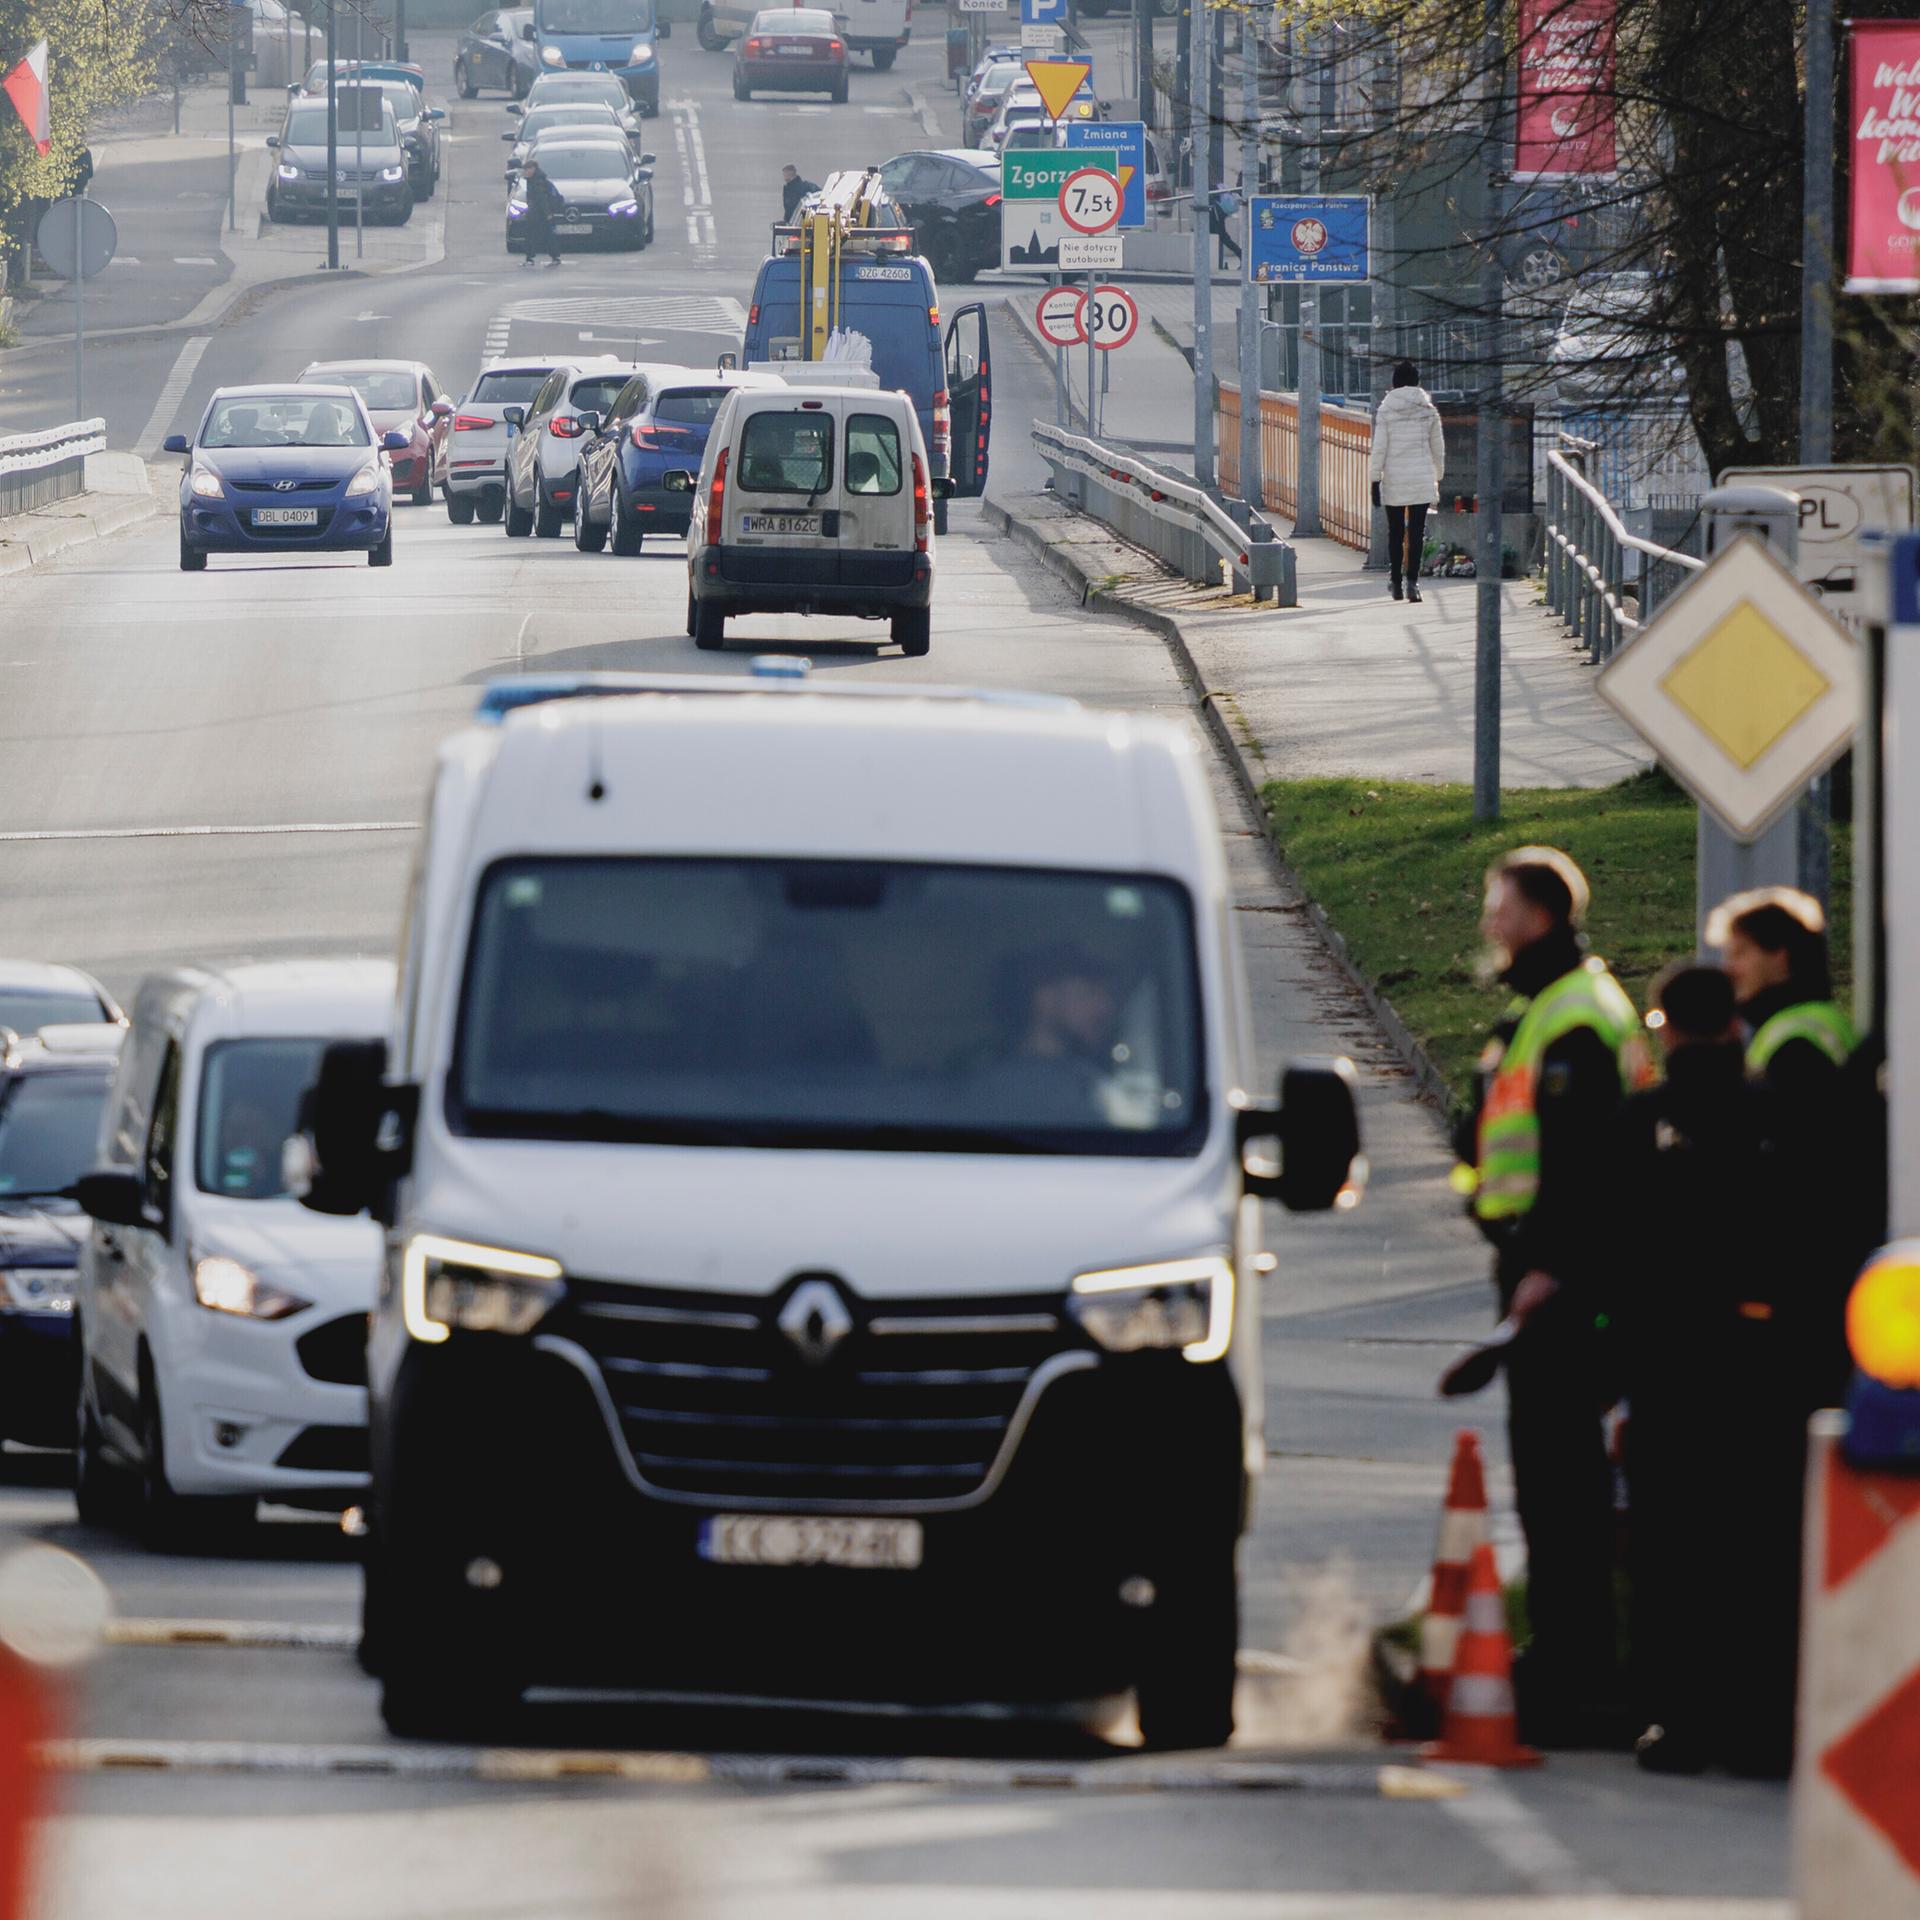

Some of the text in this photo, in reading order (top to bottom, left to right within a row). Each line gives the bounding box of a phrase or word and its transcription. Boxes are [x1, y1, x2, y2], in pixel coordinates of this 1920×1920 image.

[1031, 0, 1057, 19] P
[1083, 128, 1128, 140] Zmiana
[1011, 165, 1084, 188] Zgorz
[1063, 243, 1118, 254] Nie dotyczy
[1262, 261, 1307, 272] ranica
[1085, 302, 1128, 332] 30
[259, 510, 315, 522] DBL 04091
[1798, 498, 1840, 529] PL
[750, 516, 819, 532] WRA 8162C
